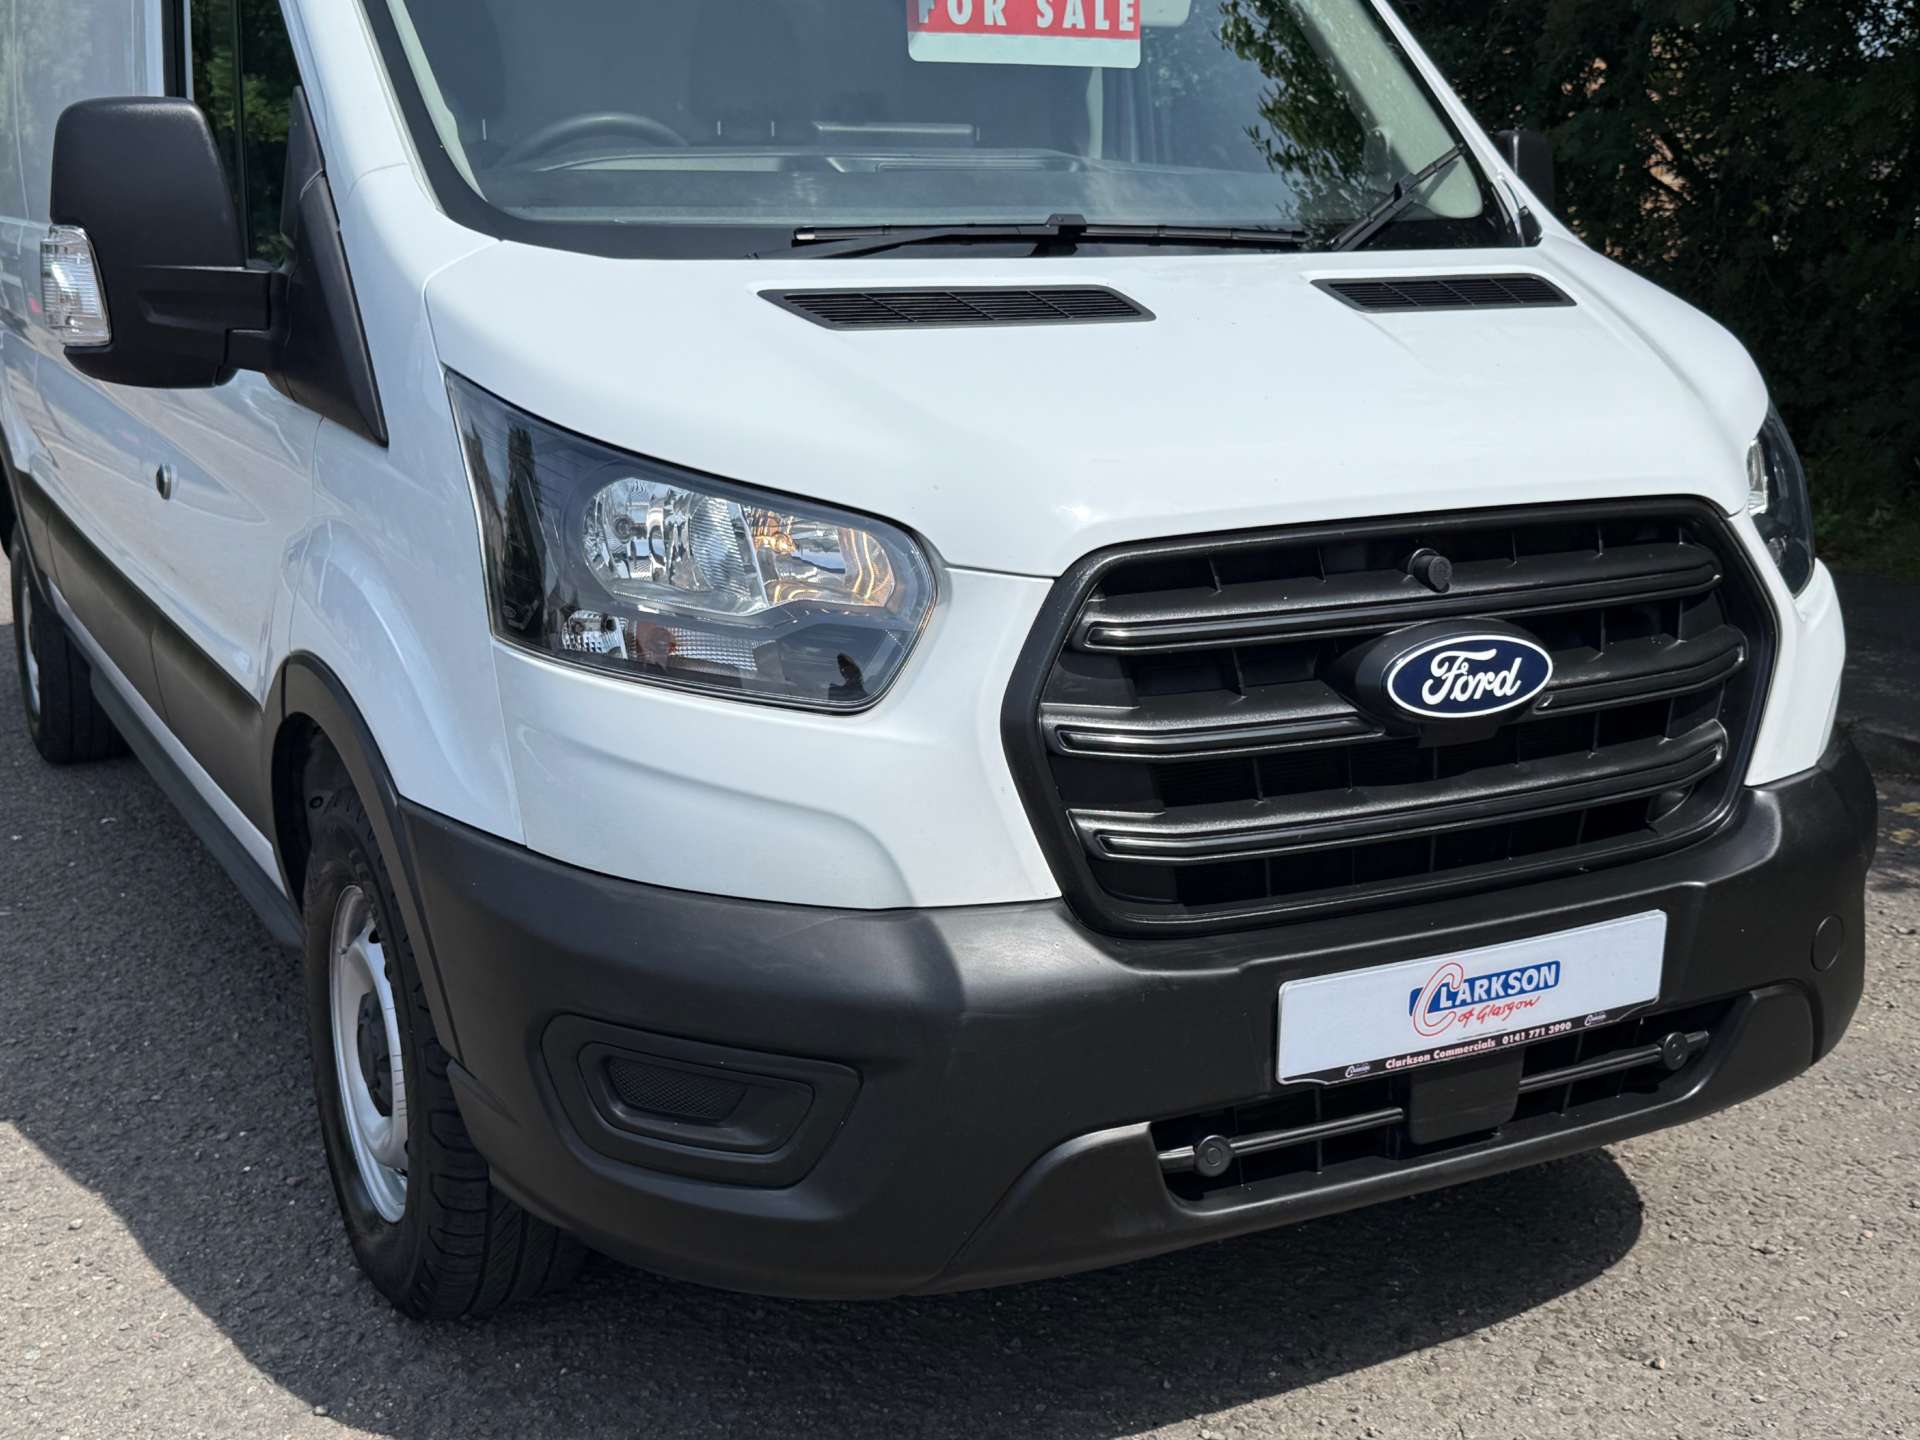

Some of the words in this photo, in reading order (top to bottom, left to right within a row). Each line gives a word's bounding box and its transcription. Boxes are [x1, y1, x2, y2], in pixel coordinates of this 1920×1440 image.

[1036, 0, 1135, 32] SALE
[1421, 648, 1522, 705] Ford
[1413, 962, 1557, 1037] CLARKSON
[1457, 1007, 1474, 1028] of
[1476, 996, 1541, 1025] Glasgow
[1385, 1052, 1431, 1069] Clarkson
[1433, 1038, 1496, 1059] Commercials
[1502, 1030, 1526, 1045] 0141
[1528, 1025, 1546, 1038] 771
[1549, 1021, 1572, 1034] 3990
